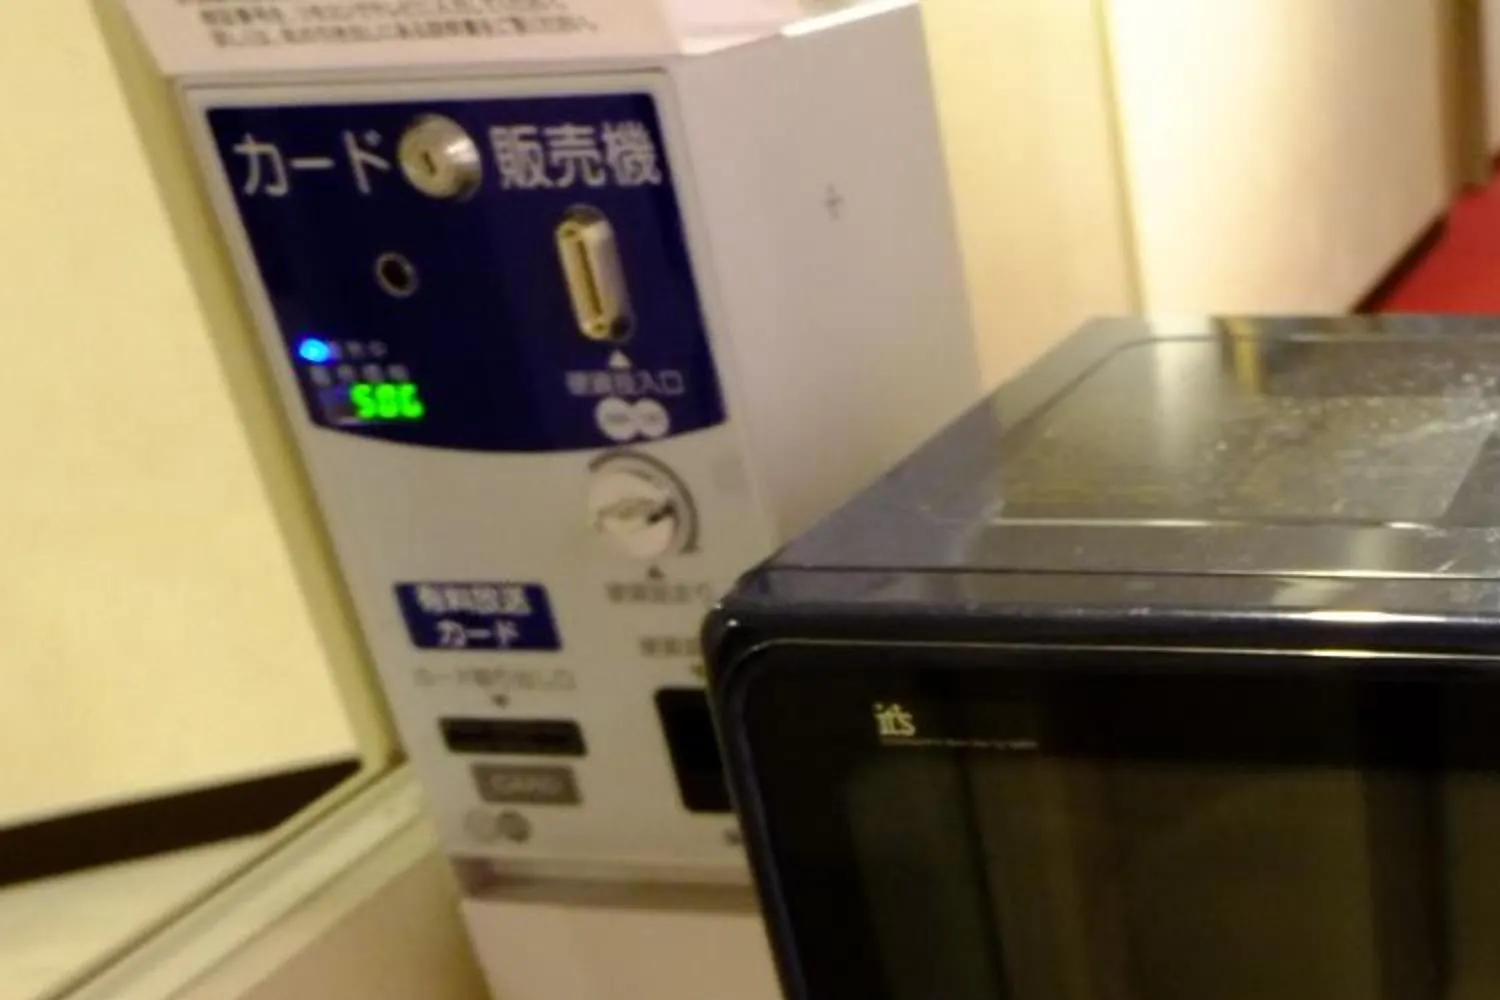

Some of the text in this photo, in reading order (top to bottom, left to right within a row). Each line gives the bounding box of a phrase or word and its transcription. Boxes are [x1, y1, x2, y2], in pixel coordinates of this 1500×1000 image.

[232, 119, 663, 197] カード 販売機
[436, 619, 520, 648] カード
